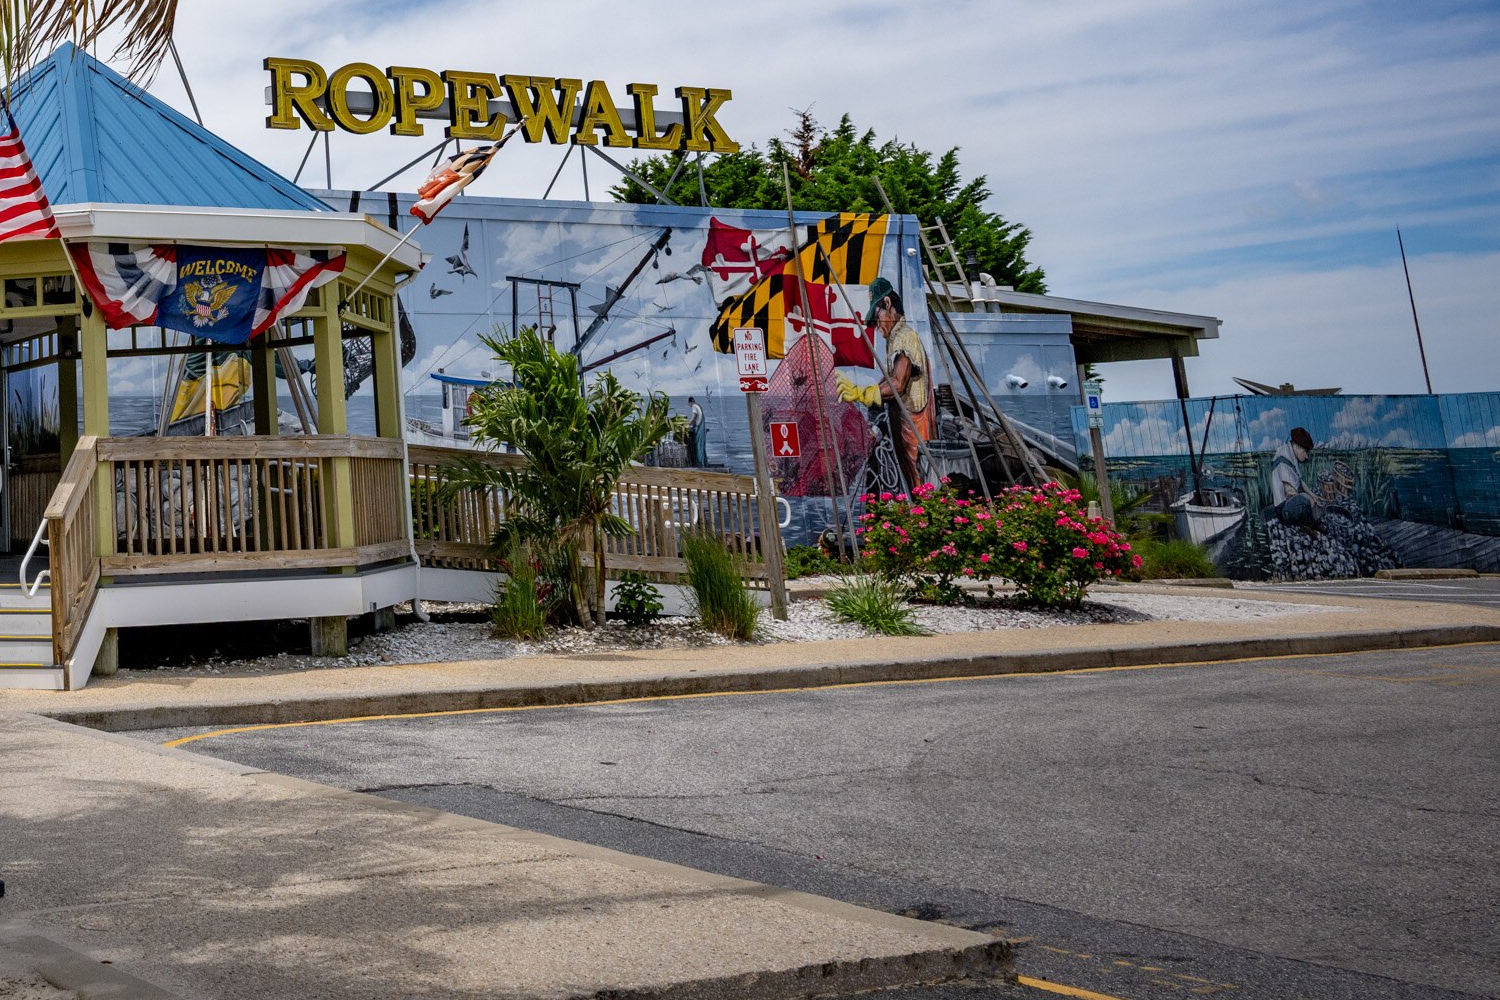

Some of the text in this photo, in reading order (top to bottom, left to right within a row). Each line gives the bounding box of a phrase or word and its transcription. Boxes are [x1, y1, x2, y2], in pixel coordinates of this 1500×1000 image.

[263, 57, 739, 153] ROPEWALK
[179, 259, 257, 284] WELCOME
[744, 333, 753, 341] NO
[737, 343, 762, 351] PARKING
[744, 353, 758, 361] FIRE
[744, 363, 760, 371] LANE
